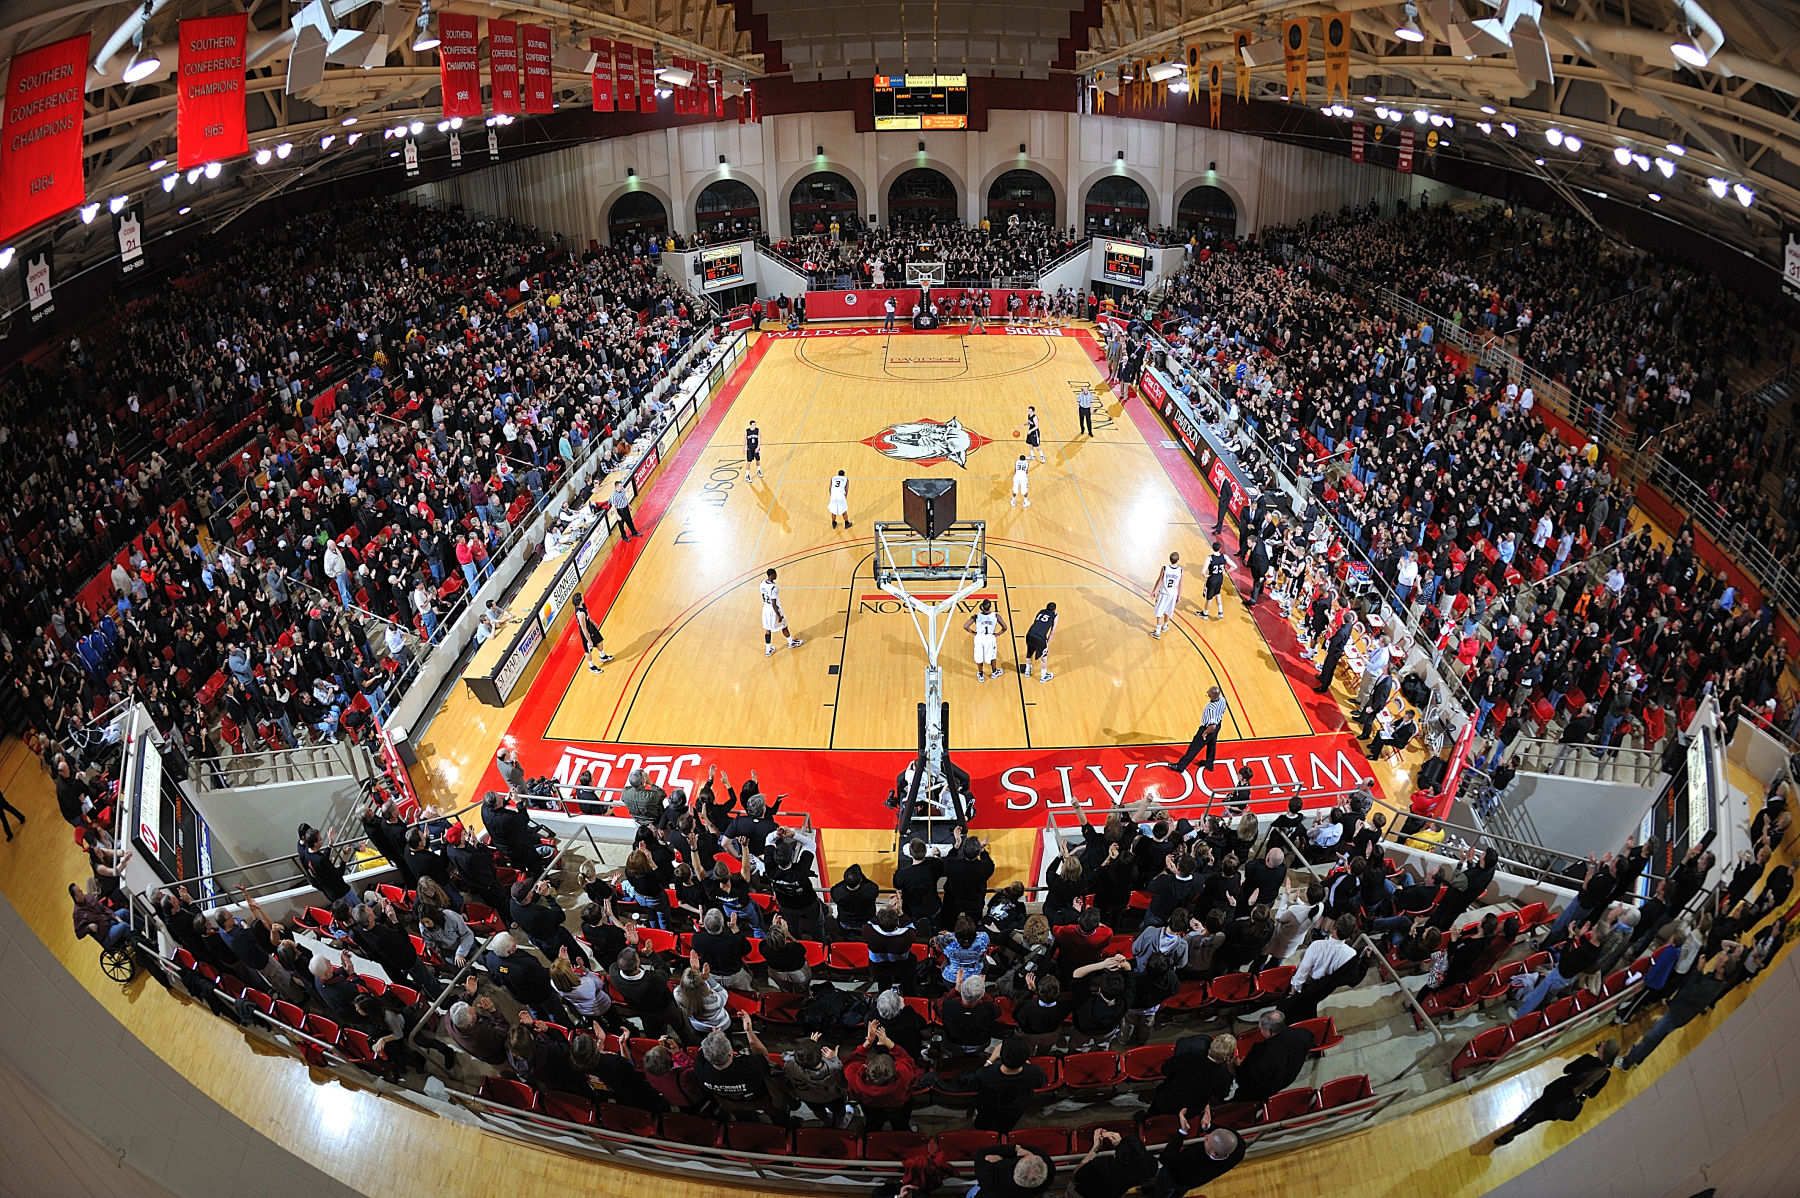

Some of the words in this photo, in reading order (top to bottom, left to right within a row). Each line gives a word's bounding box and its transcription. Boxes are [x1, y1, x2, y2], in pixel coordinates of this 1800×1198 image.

[446, 30, 472, 40] SOUTHERN
[191, 35, 237, 52] SOUTHERN
[444, 46, 477, 55] CONFERENCE
[491, 49, 517, 58] CONFERENCE
[525, 53, 551, 62] CONFERENCE
[184, 56, 241, 76] CONFERENCE
[446, 61, 476, 71] CHAMPIONS
[495, 64, 517, 73] CHAMPIONS
[18, 63, 75, 93] SOUTHERN
[188, 79, 239, 98] CHAMPIONS
[9, 86, 80, 124] CONFERENCE
[11, 113, 75, 151] CHAMPIONS
[126, 239, 137, 253] 21
[33, 282, 46, 298] 10
[765, 328, 900, 339] WILDCATS
[1004, 326, 1063, 337] SOCON
[1174, 409, 1201, 446] DAVIDSON
[834, 480, 841, 488] 3
[1167, 579, 1174, 588] 2
[984, 626, 989, 635] 1
[1000, 749, 1364, 810] WILDCATS
